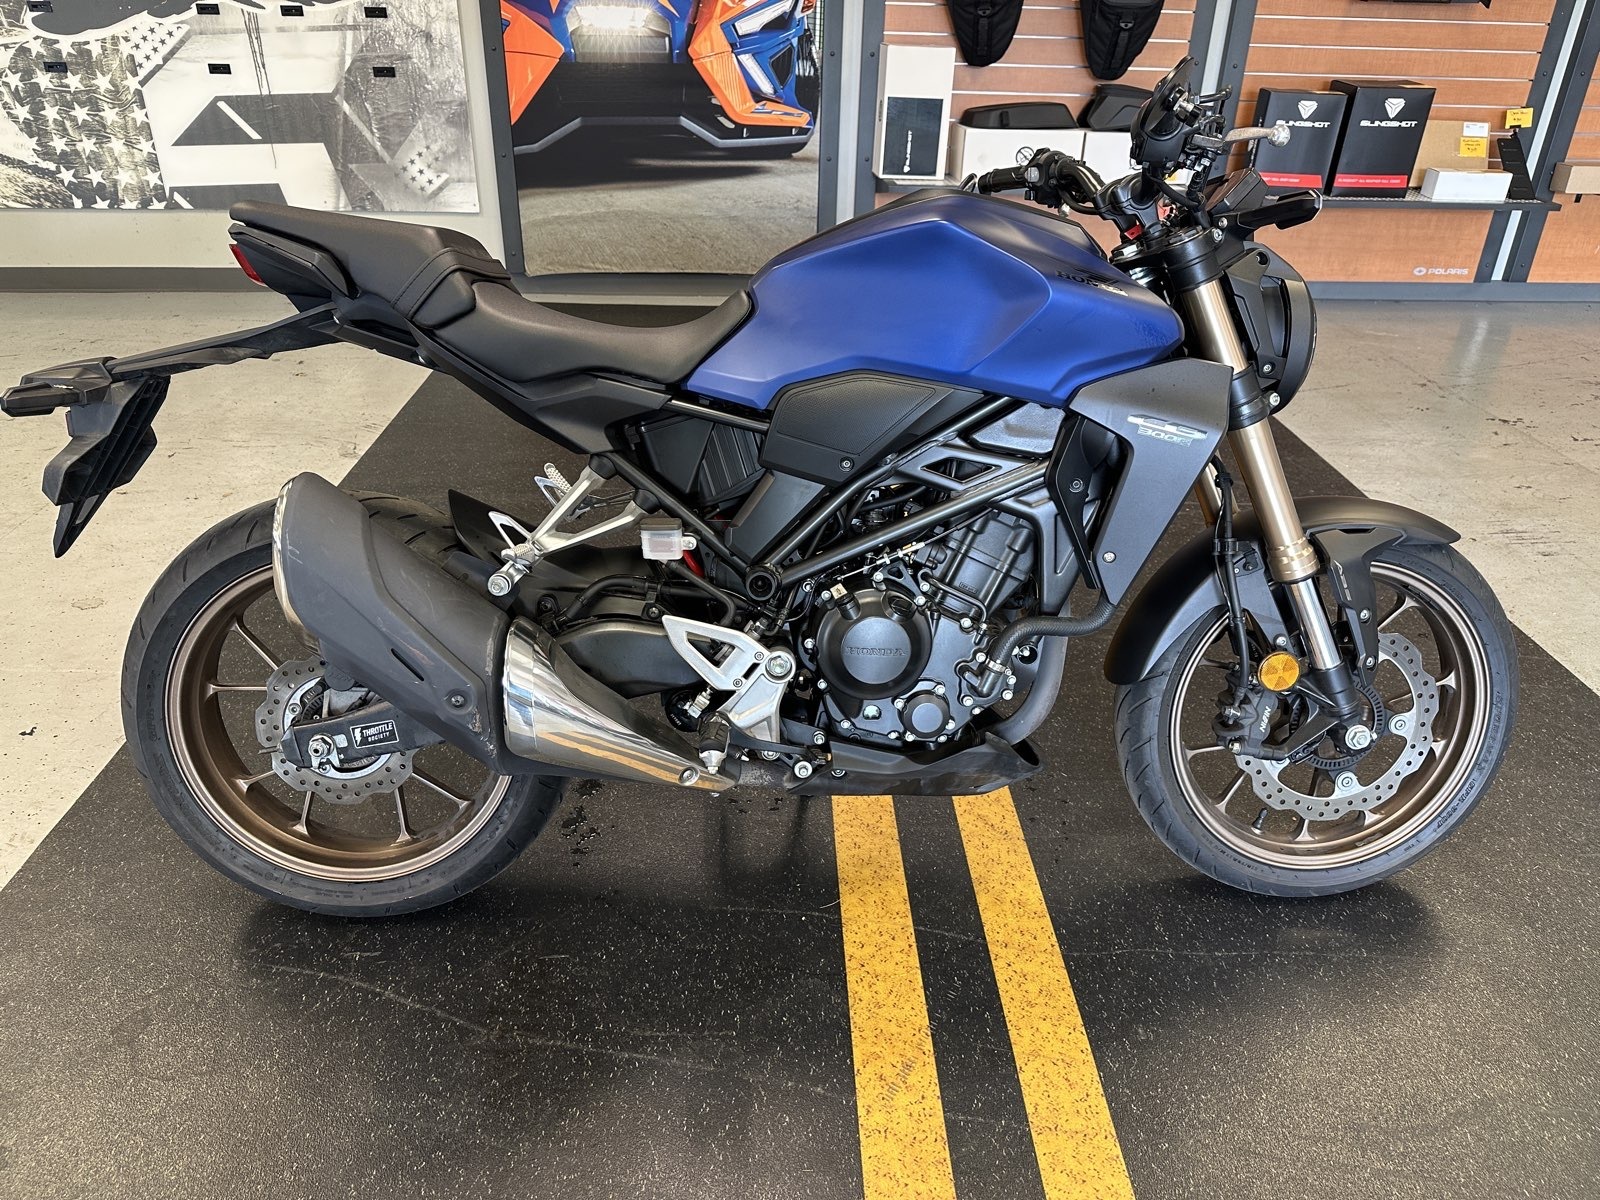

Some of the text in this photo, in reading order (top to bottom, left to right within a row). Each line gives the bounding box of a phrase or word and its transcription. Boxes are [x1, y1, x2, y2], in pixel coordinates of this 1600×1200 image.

[1275, 119, 1331, 128] SLINGSHOT
[1359, 119, 1418, 128] SLINGSHOT
[1427, 267, 1469, 275] POLARIS
[846, 646, 907, 657] HONDA
[362, 722, 393, 738] THROTTLE
[367, 731, 390, 742] SOCIETY
